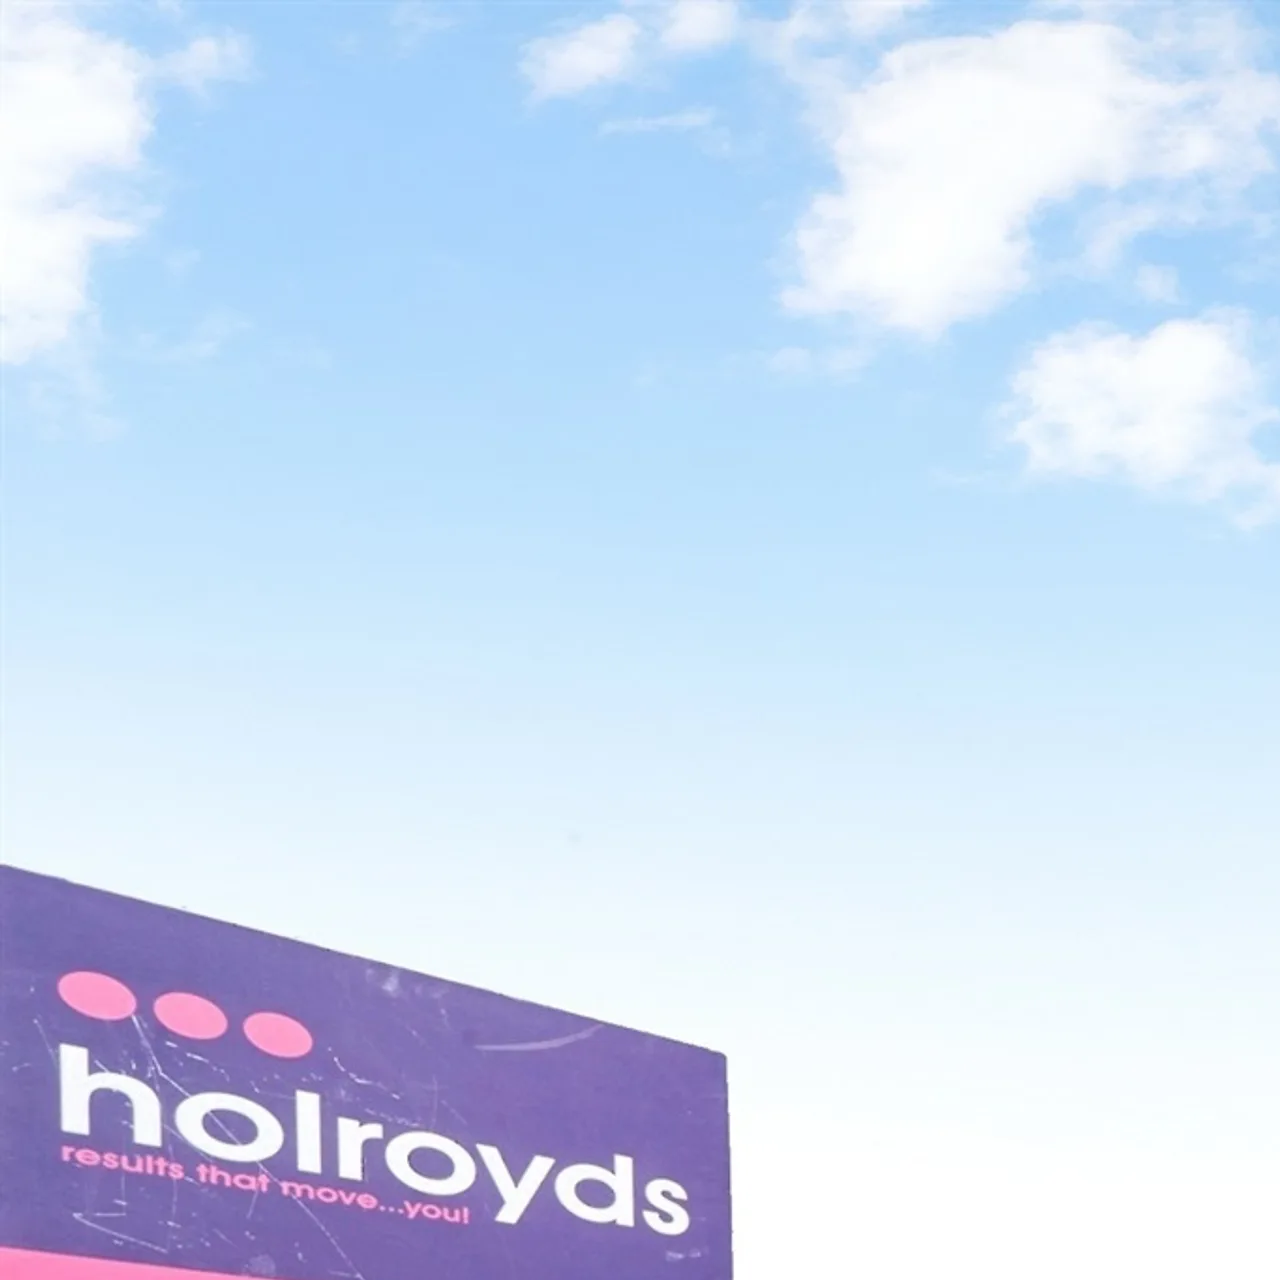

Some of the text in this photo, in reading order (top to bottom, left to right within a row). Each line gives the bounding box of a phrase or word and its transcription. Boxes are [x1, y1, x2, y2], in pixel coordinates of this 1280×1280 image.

[59, 1042, 690, 1236] holroyds
[61, 1145, 185, 1180] results
[195, 1163, 271, 1193] that
